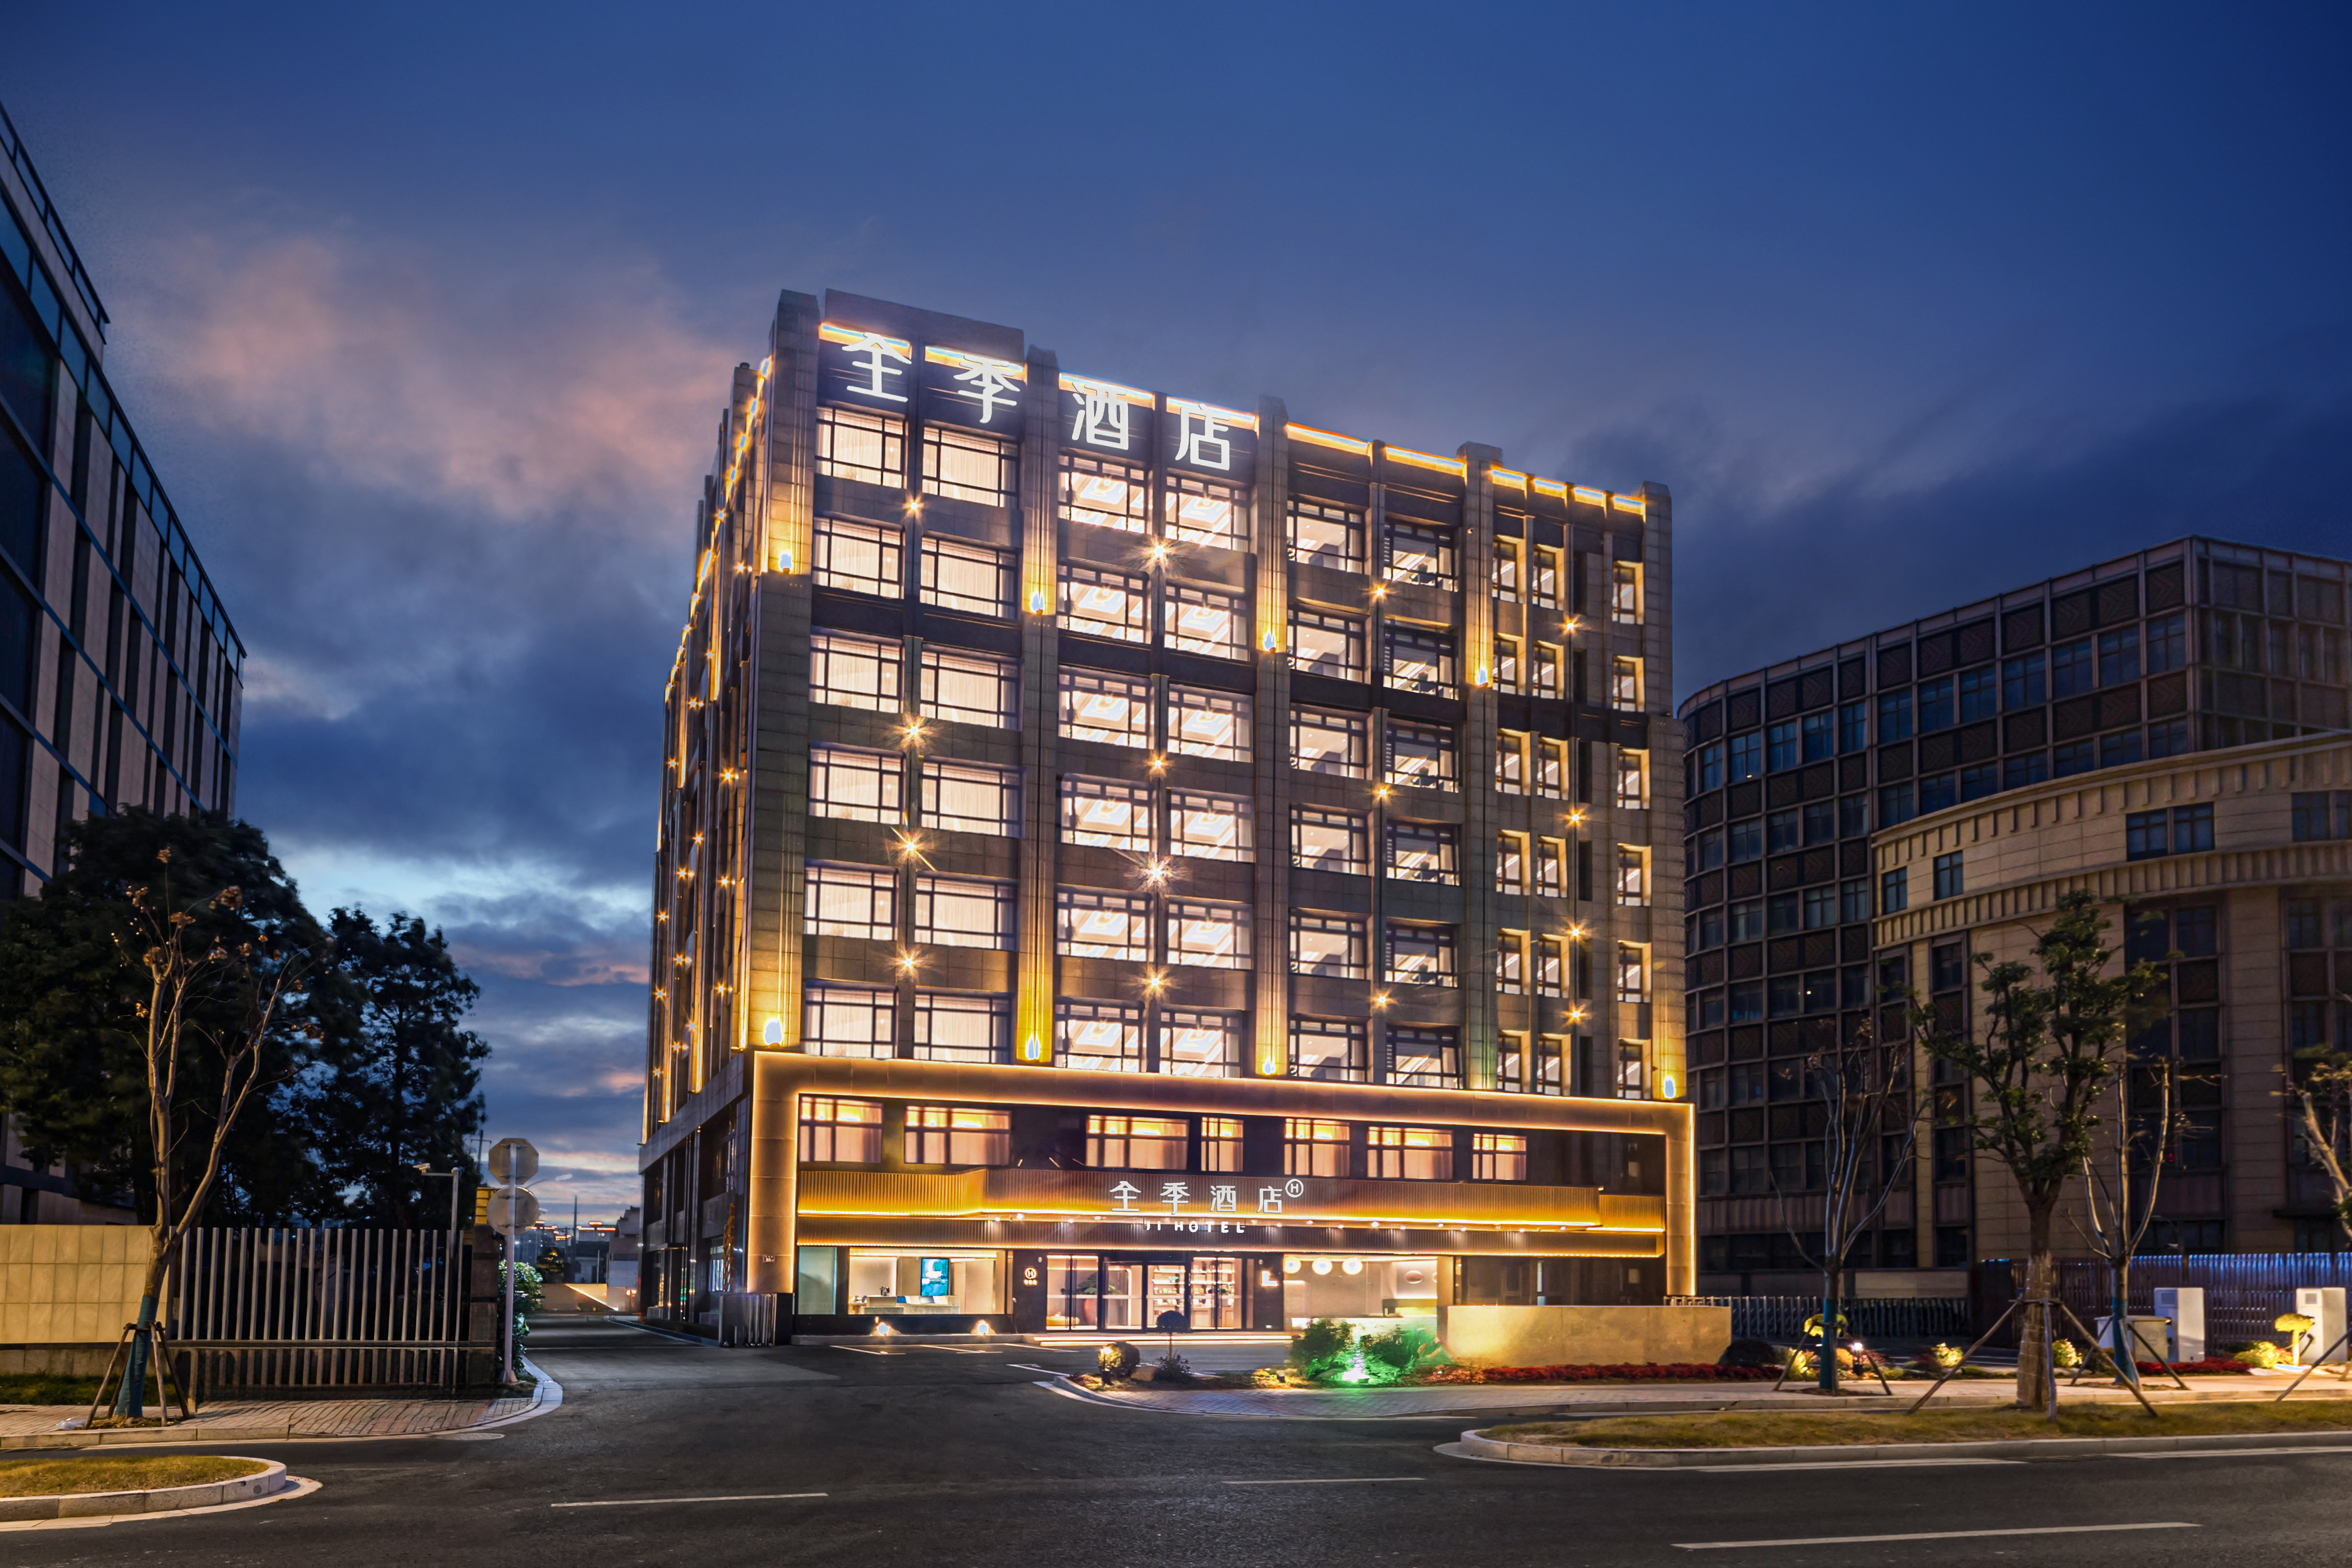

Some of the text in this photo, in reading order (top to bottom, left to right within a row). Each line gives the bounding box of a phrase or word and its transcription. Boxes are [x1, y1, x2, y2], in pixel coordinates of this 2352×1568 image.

[841, 332, 1231, 471] 全季酒店
[1109, 1180, 1283, 1215] 全季酒店
[1145, 1221, 1245, 1233] JI HOTEL
